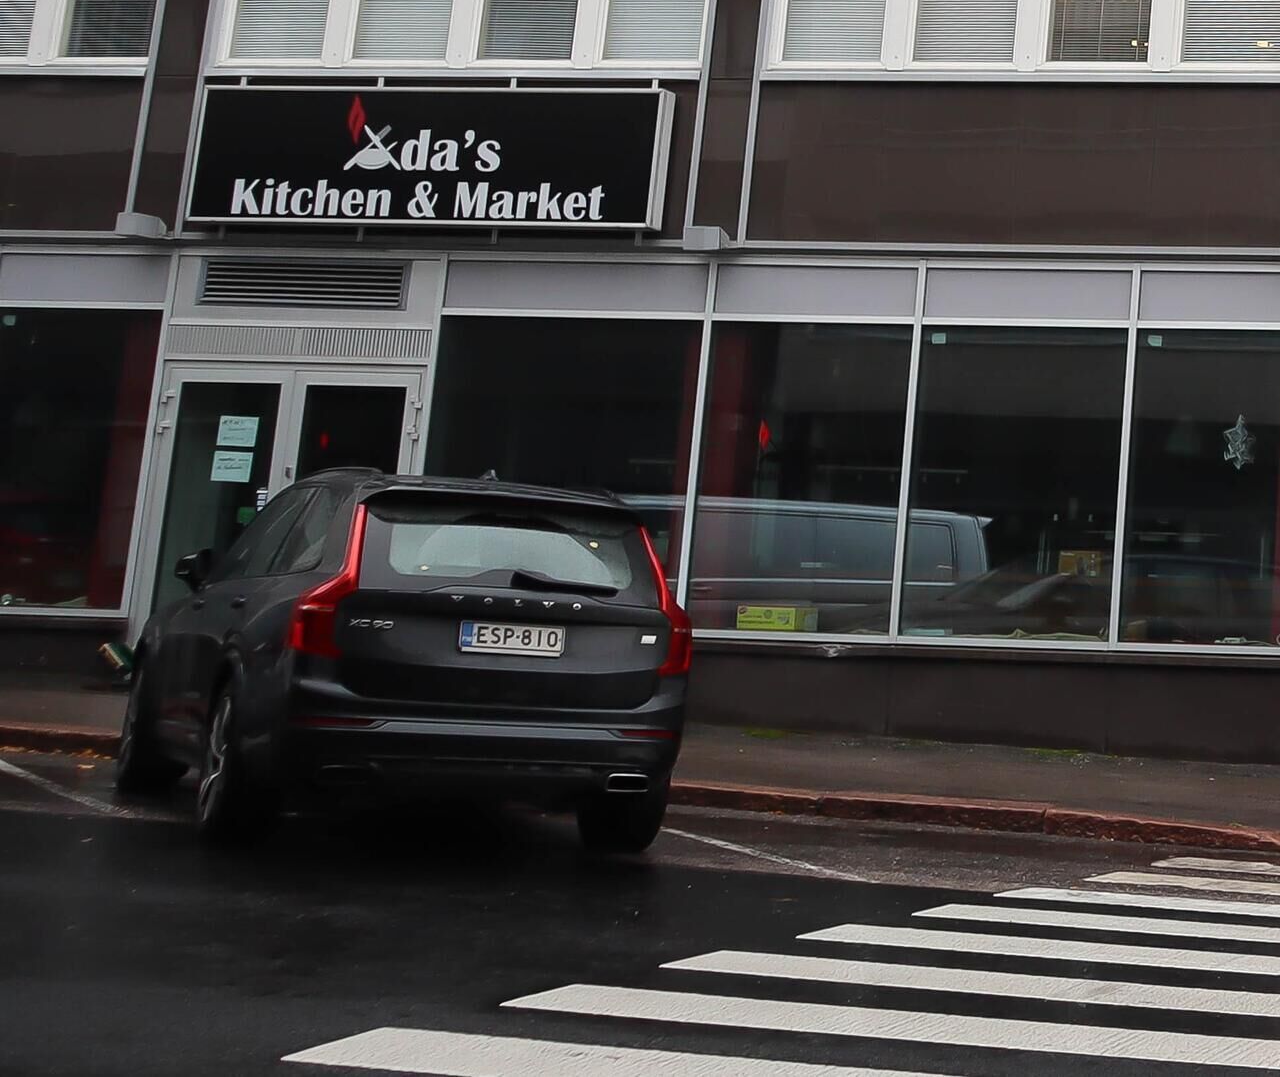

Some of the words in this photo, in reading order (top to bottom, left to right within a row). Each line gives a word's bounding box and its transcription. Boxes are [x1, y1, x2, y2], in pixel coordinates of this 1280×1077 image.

[230, 178, 392, 217] Kitchen
[407, 181, 438, 218] &
[453, 182, 605, 220] Market
[476, 625, 559, 648] ESP-810
